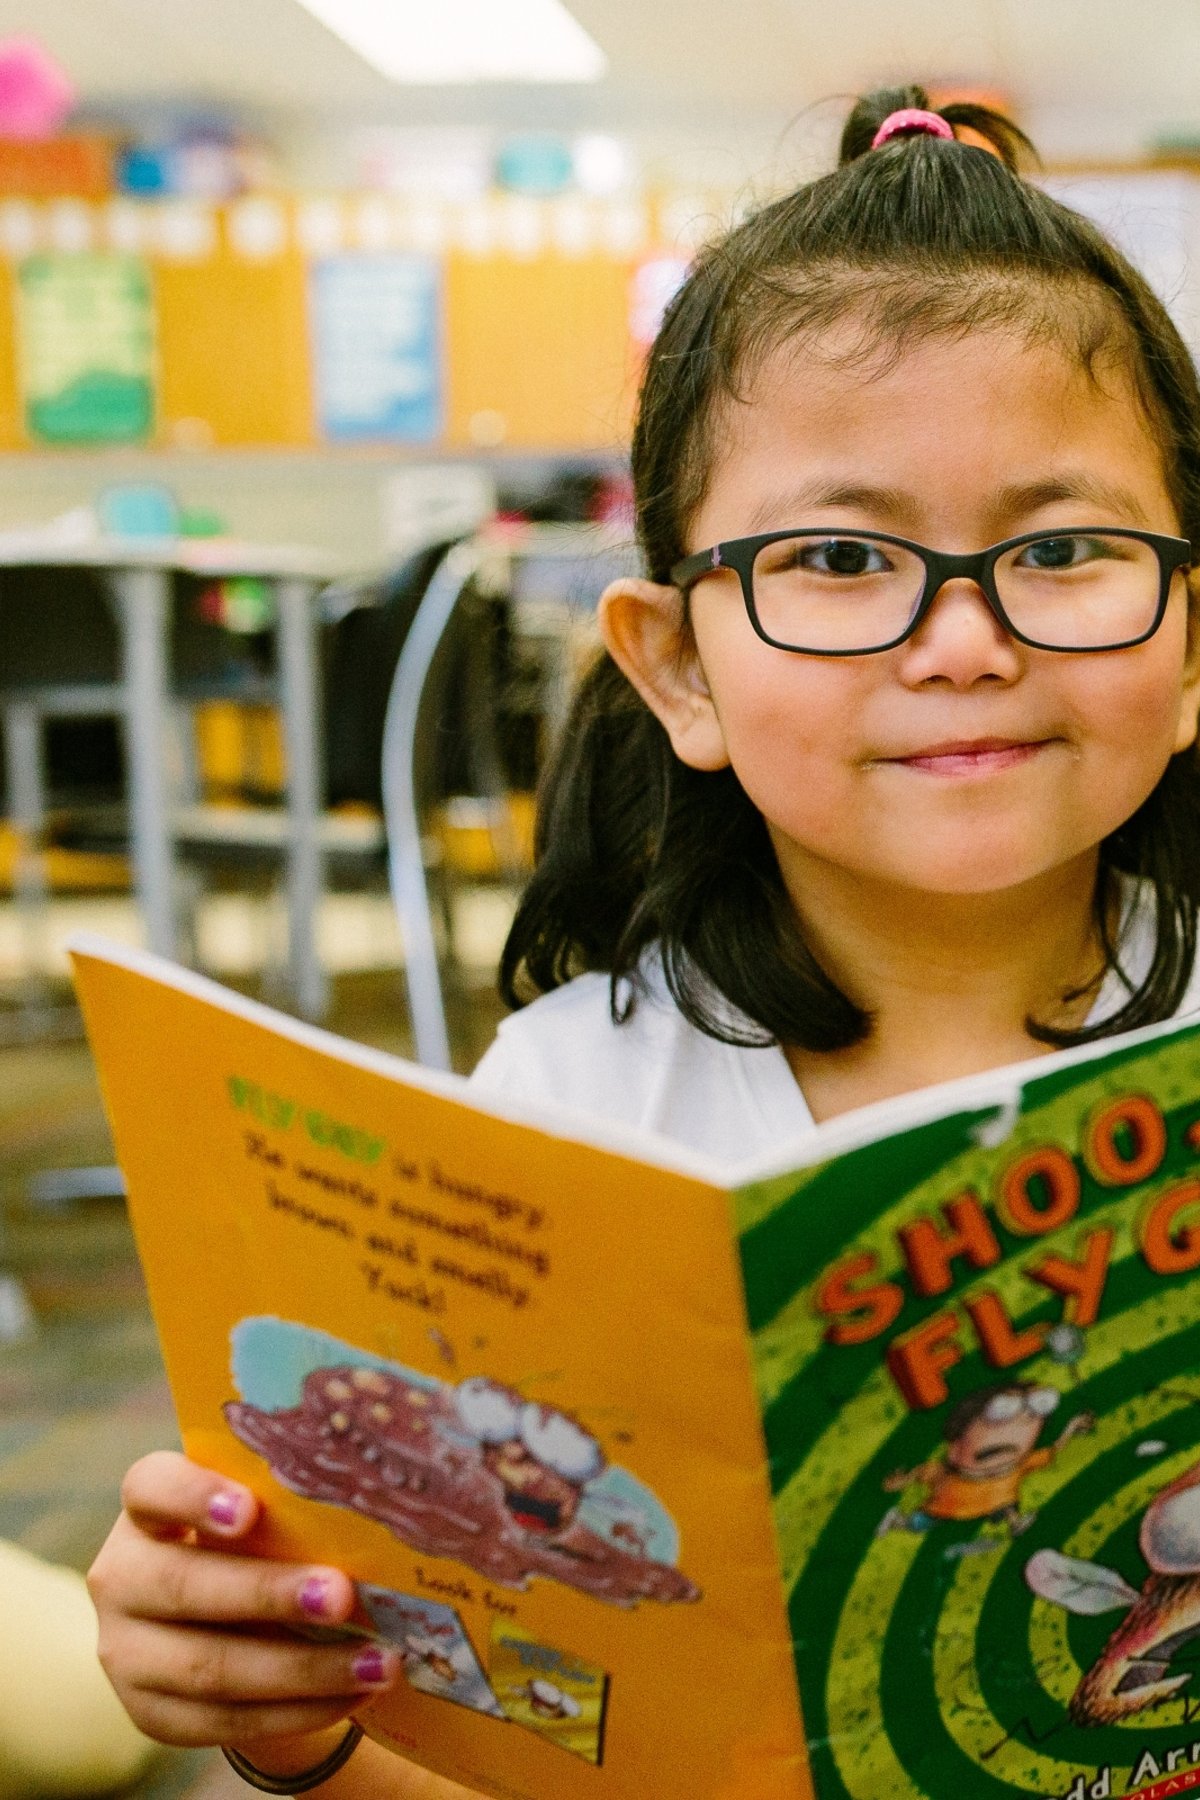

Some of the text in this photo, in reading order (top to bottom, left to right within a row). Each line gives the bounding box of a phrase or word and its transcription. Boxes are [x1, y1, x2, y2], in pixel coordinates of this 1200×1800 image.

[295, 1163, 378, 1209] wants
[389, 1199, 550, 1278] something
[365, 1231, 420, 1267] and
[886, 1228, 1114, 1410] FLY
[1044, 1766, 1110, 1800] dd
